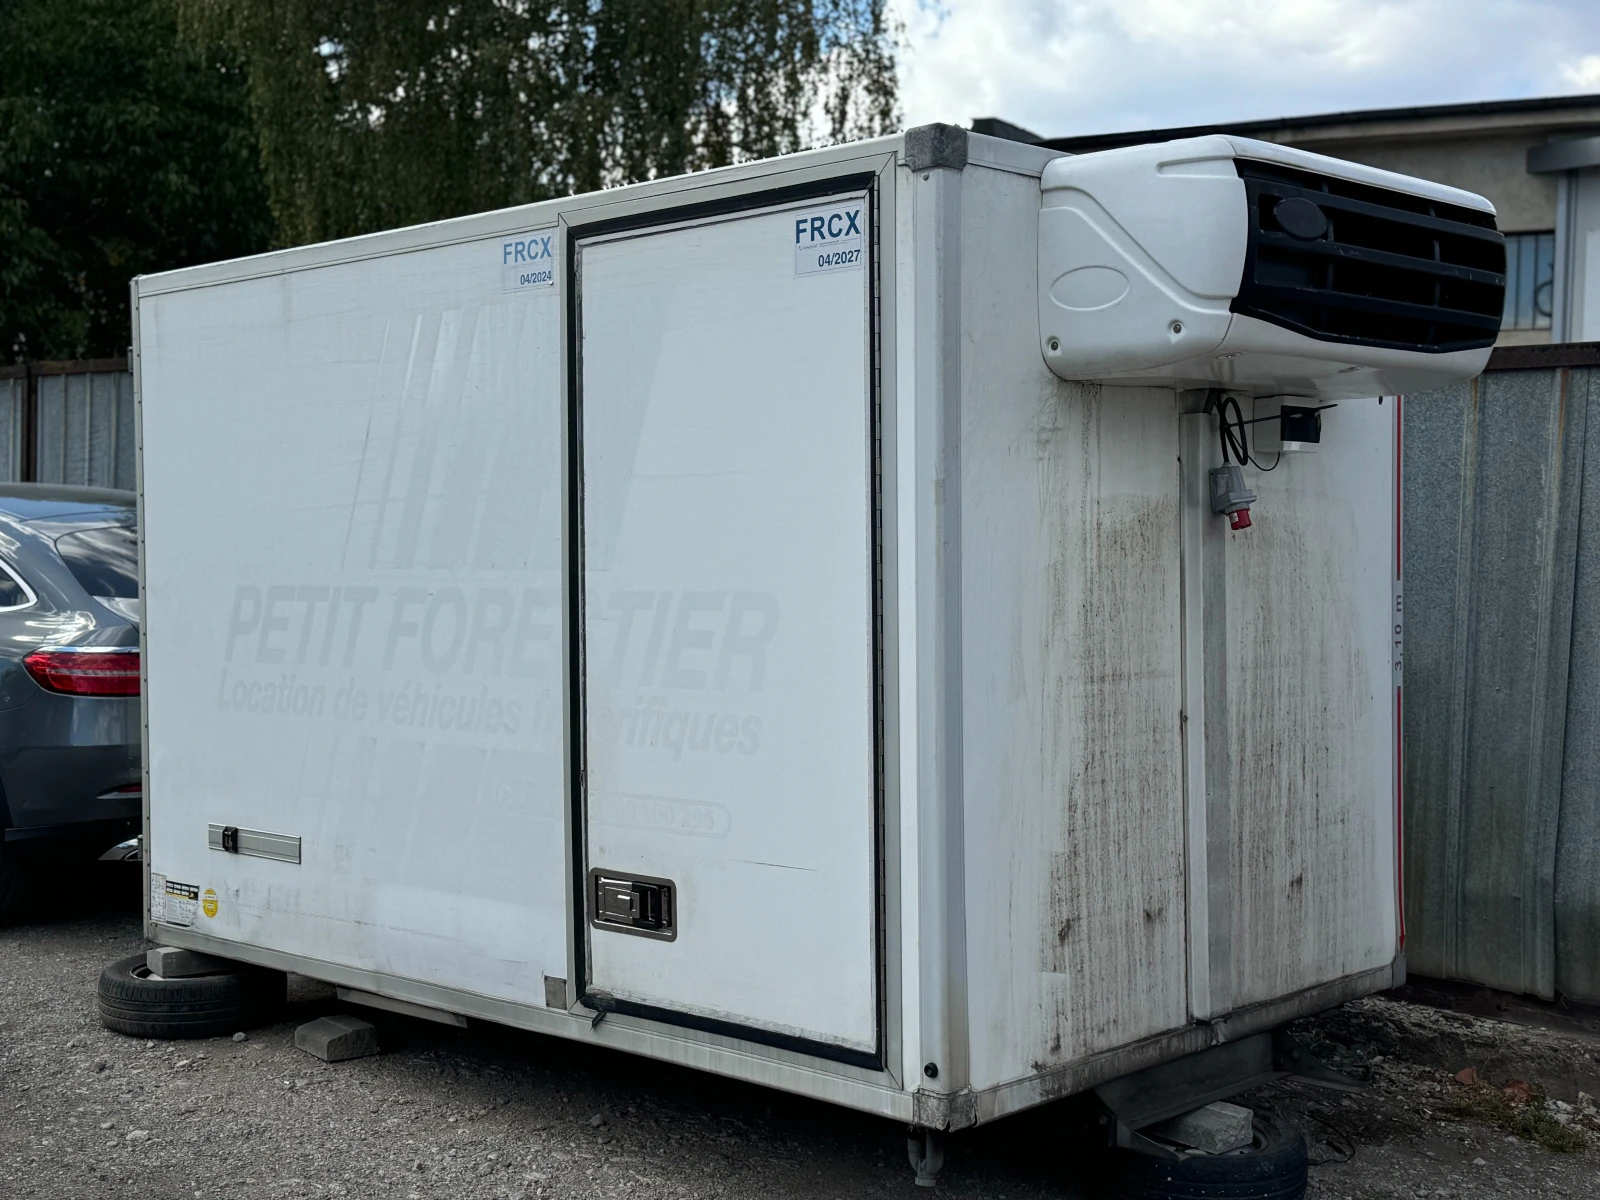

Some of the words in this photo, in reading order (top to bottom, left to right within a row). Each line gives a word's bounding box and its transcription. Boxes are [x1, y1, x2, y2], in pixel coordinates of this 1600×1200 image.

[796, 209, 861, 244] FRCX
[503, 236, 552, 265] FRCX
[818, 249, 861, 268] 04/2027
[520, 270, 552, 285] 04/2024
[1396, 594, 1402, 612] m
[225, 585, 379, 669] PETIT
[381, 585, 780, 692] FORETIER
[1394, 623, 1404, 671] 3,10
[217, 667, 325, 717] Location
[333, 676, 368, 721] de
[378, 679, 522, 735] véhicules
